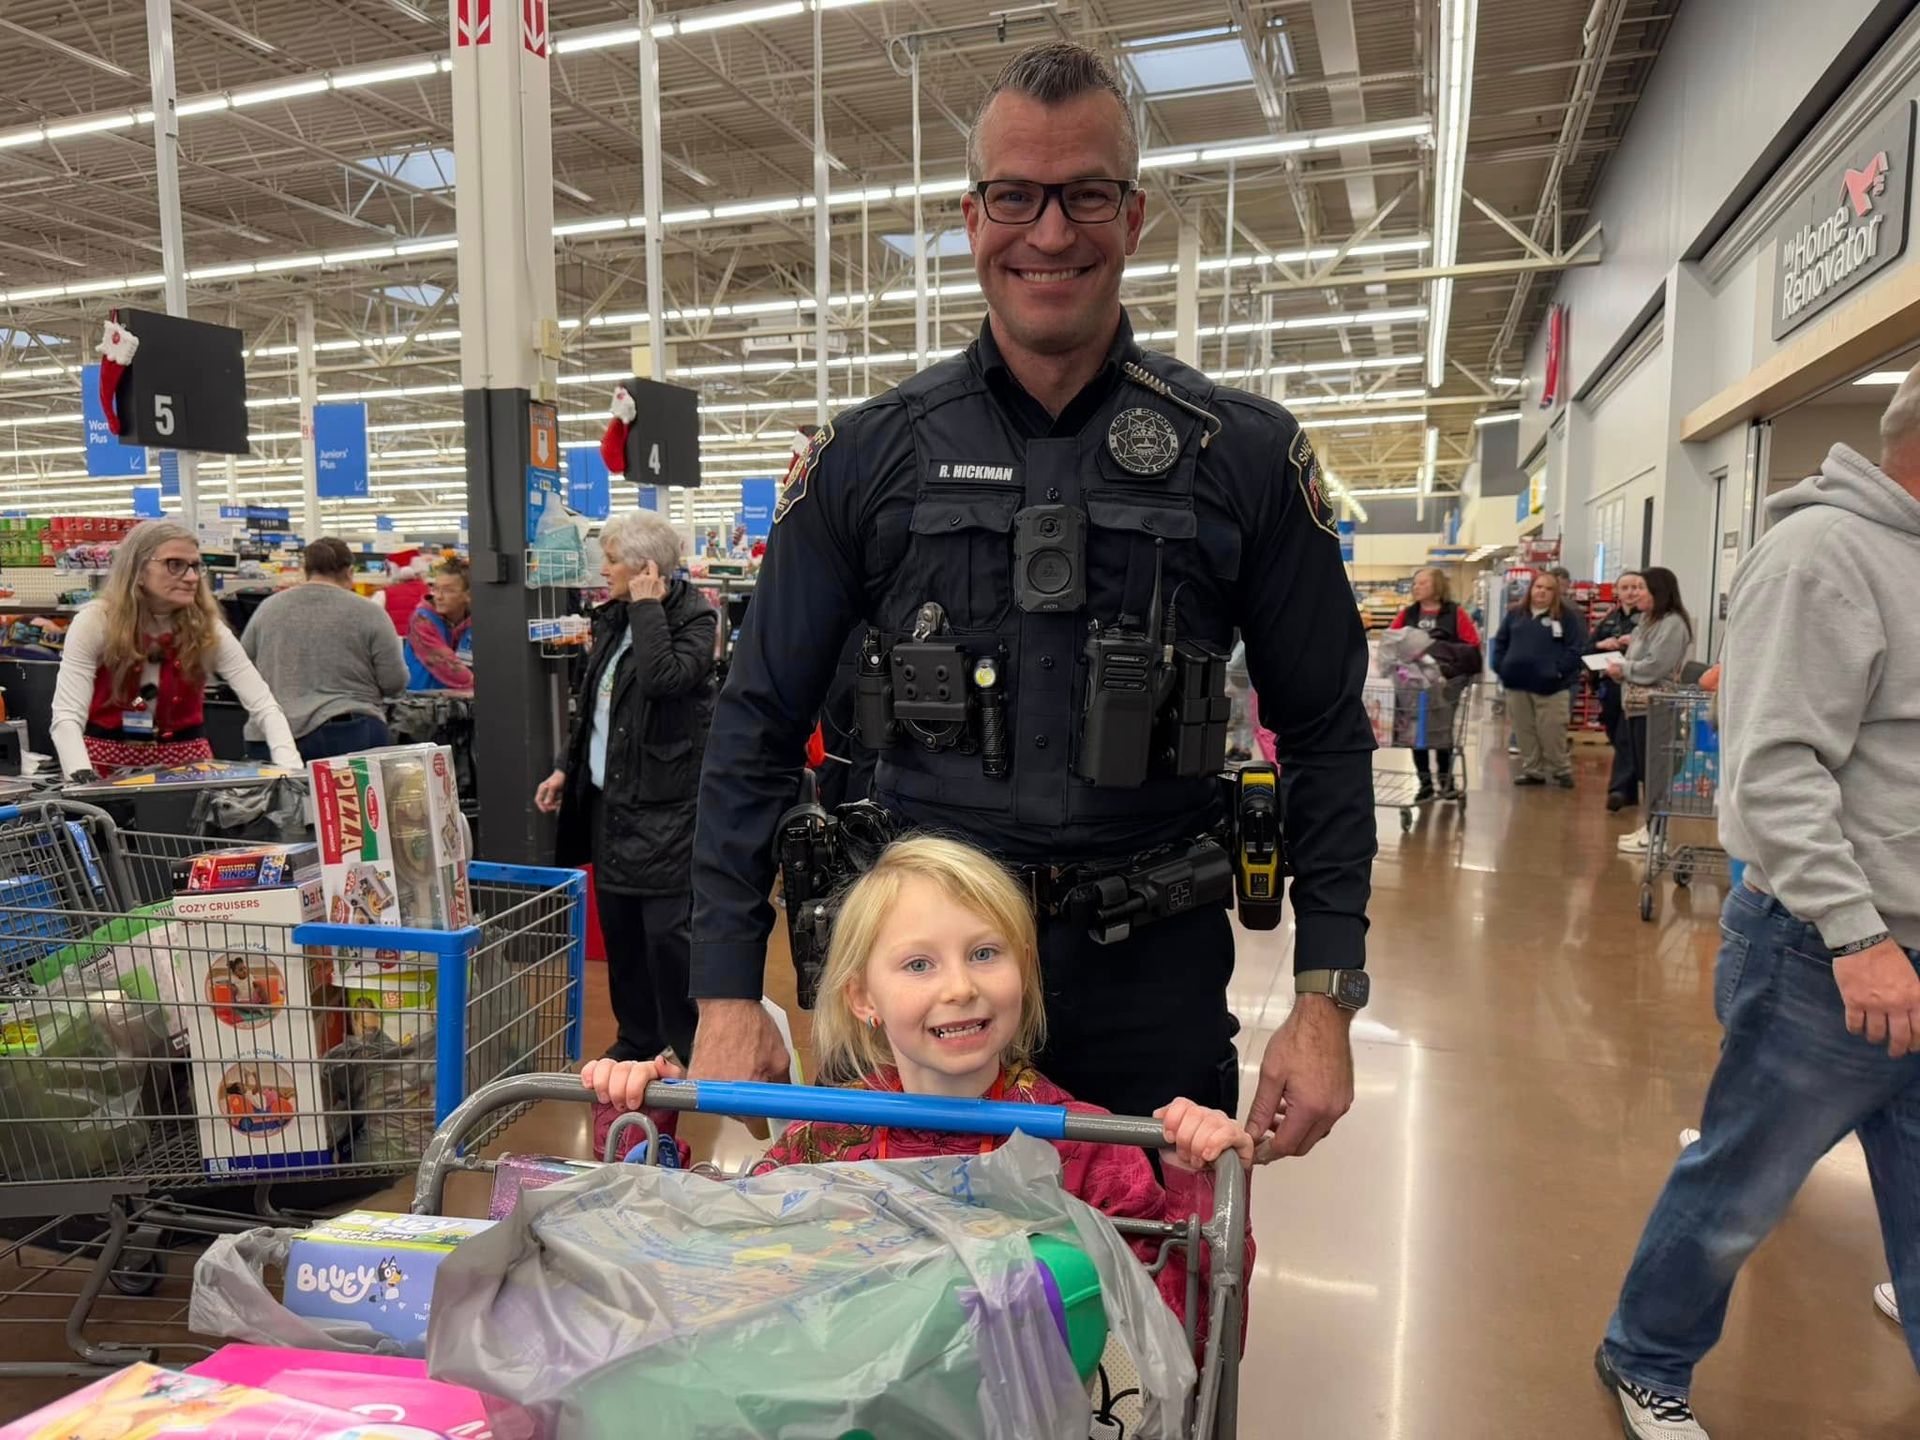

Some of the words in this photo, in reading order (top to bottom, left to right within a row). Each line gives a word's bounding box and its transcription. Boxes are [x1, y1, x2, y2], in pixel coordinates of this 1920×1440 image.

[1795, 206, 1849, 276] Home
[1782, 214, 1883, 320] Renovator
[154, 394, 174, 435] 5
[90, 433, 108, 443] Plus
[648, 443, 661, 475] 4
[939, 464, 951, 478] R.
[952, 464, 1013, 481] HICKMAN
[332, 768, 364, 855] PIZZA
[178, 903, 207, 913] COZY
[208, 899, 260, 911] CRUISERS
[297, 1263, 376, 1304] BLUEY
